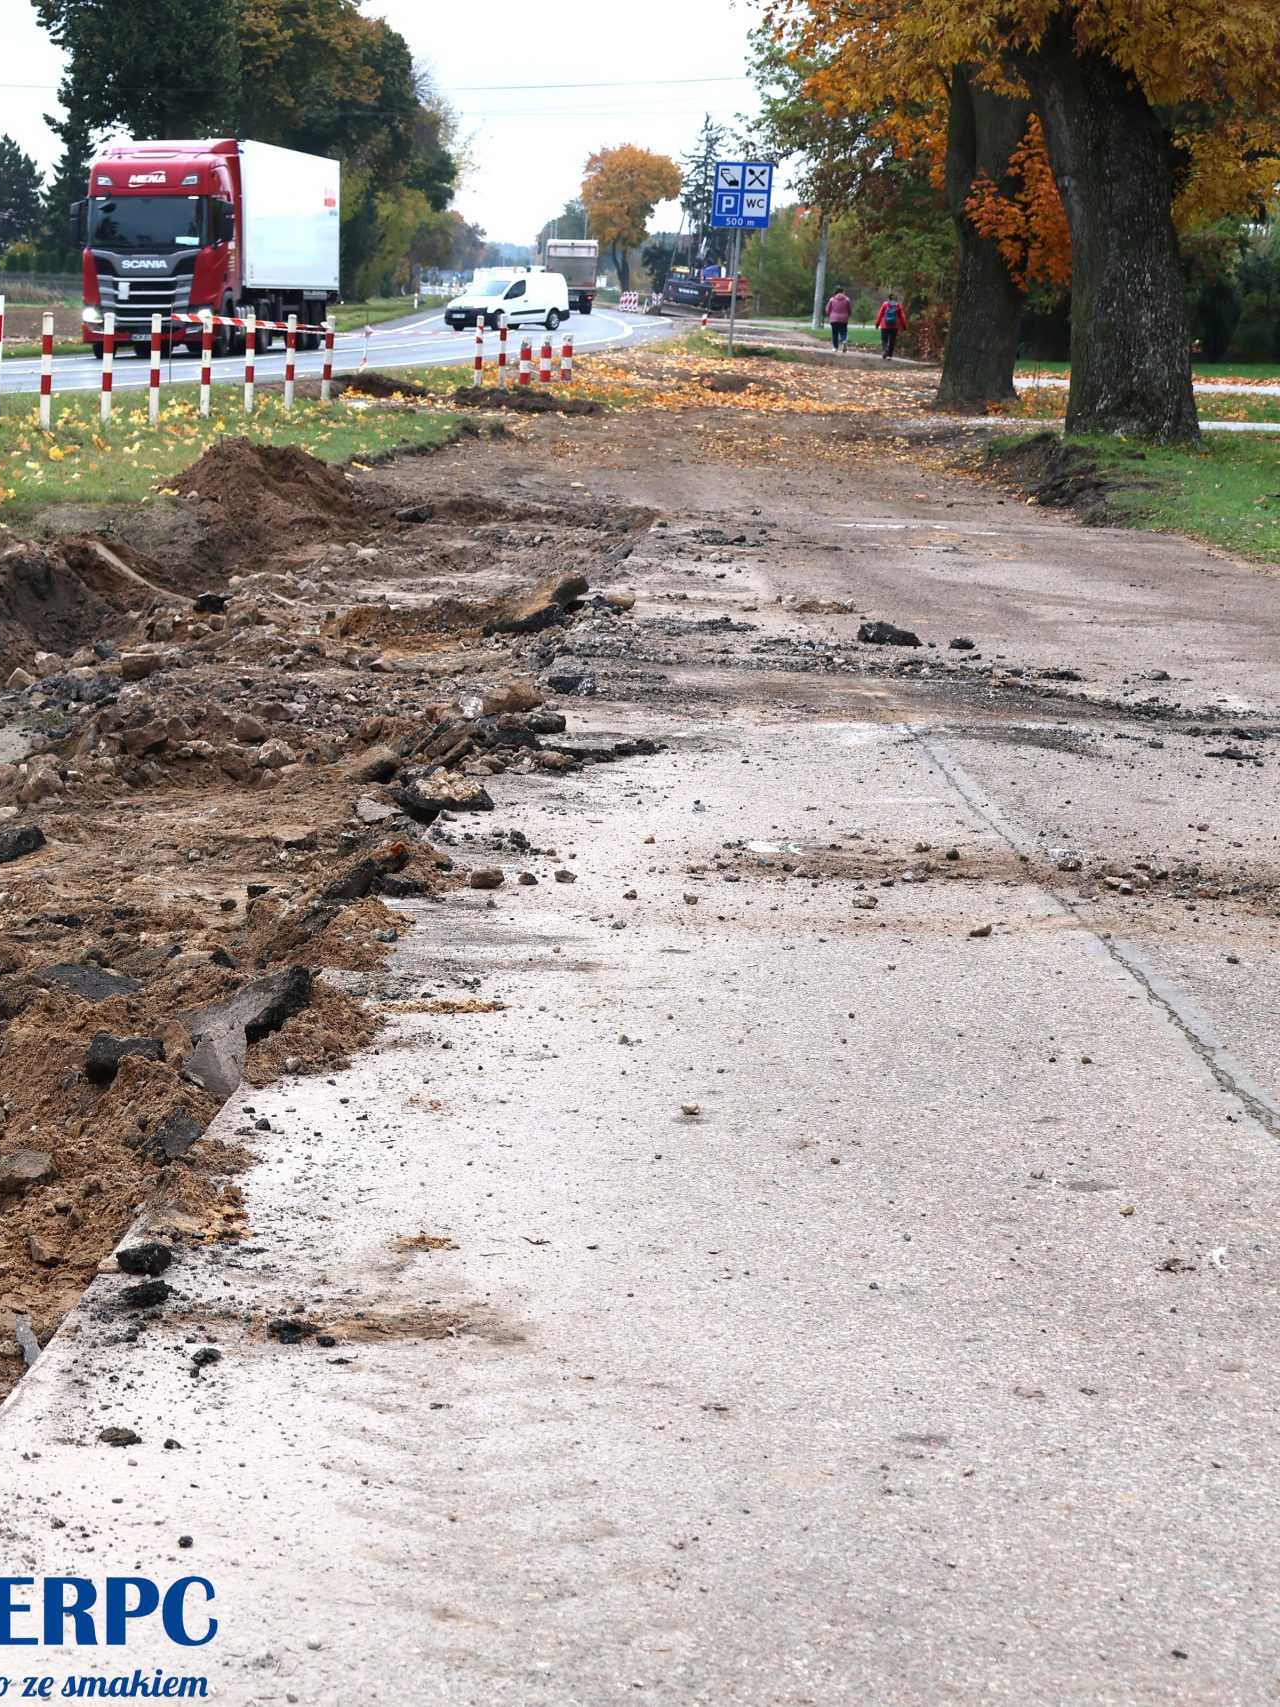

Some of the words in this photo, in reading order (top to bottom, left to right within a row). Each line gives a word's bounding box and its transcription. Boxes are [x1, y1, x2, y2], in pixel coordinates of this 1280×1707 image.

[721, 196, 735, 213] P
[746, 199, 765, 208] WC
[725, 217, 744, 226] 500
[746, 219, 755, 227] m
[121, 260, 168, 269] SCANIA
